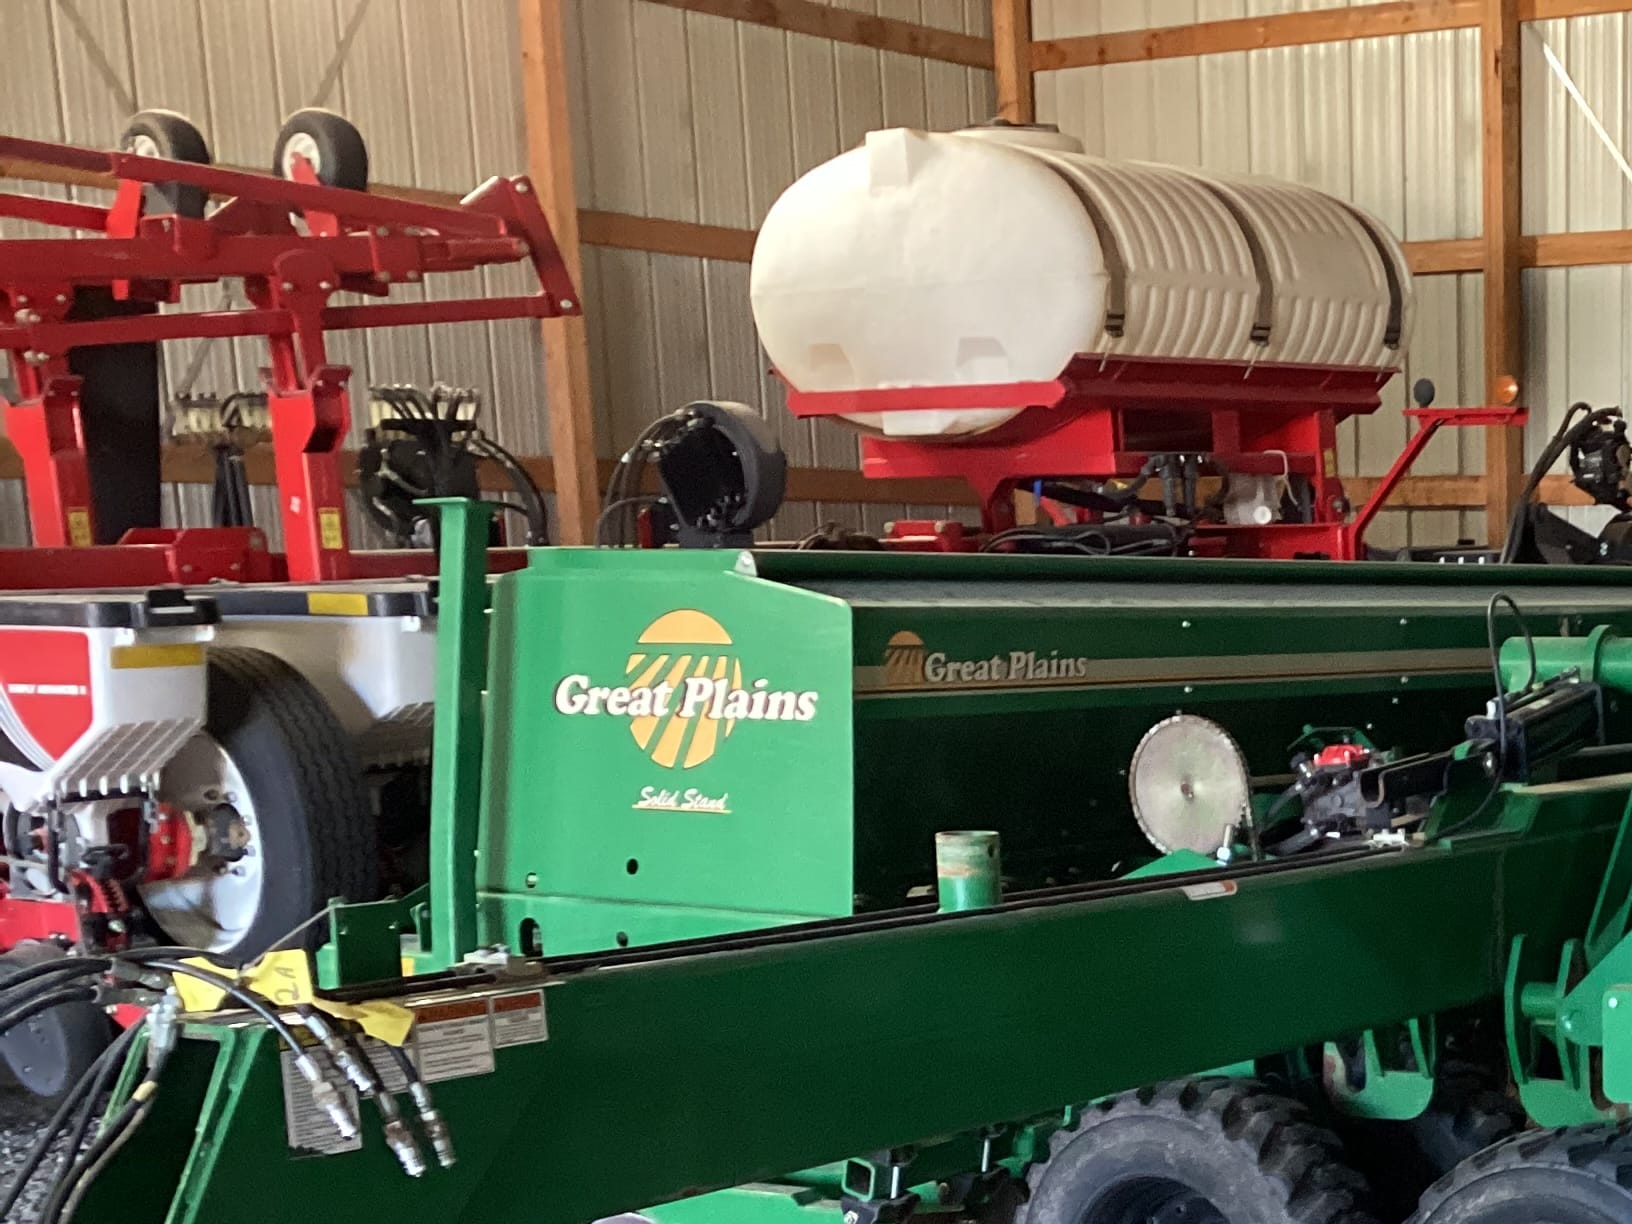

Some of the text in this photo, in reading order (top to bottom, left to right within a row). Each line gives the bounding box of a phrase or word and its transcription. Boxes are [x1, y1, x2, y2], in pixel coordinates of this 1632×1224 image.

[926, 650, 1088, 682] Great Plains
[555, 675, 818, 720] Great Plains
[638, 786, 728, 809] Solid Stand
